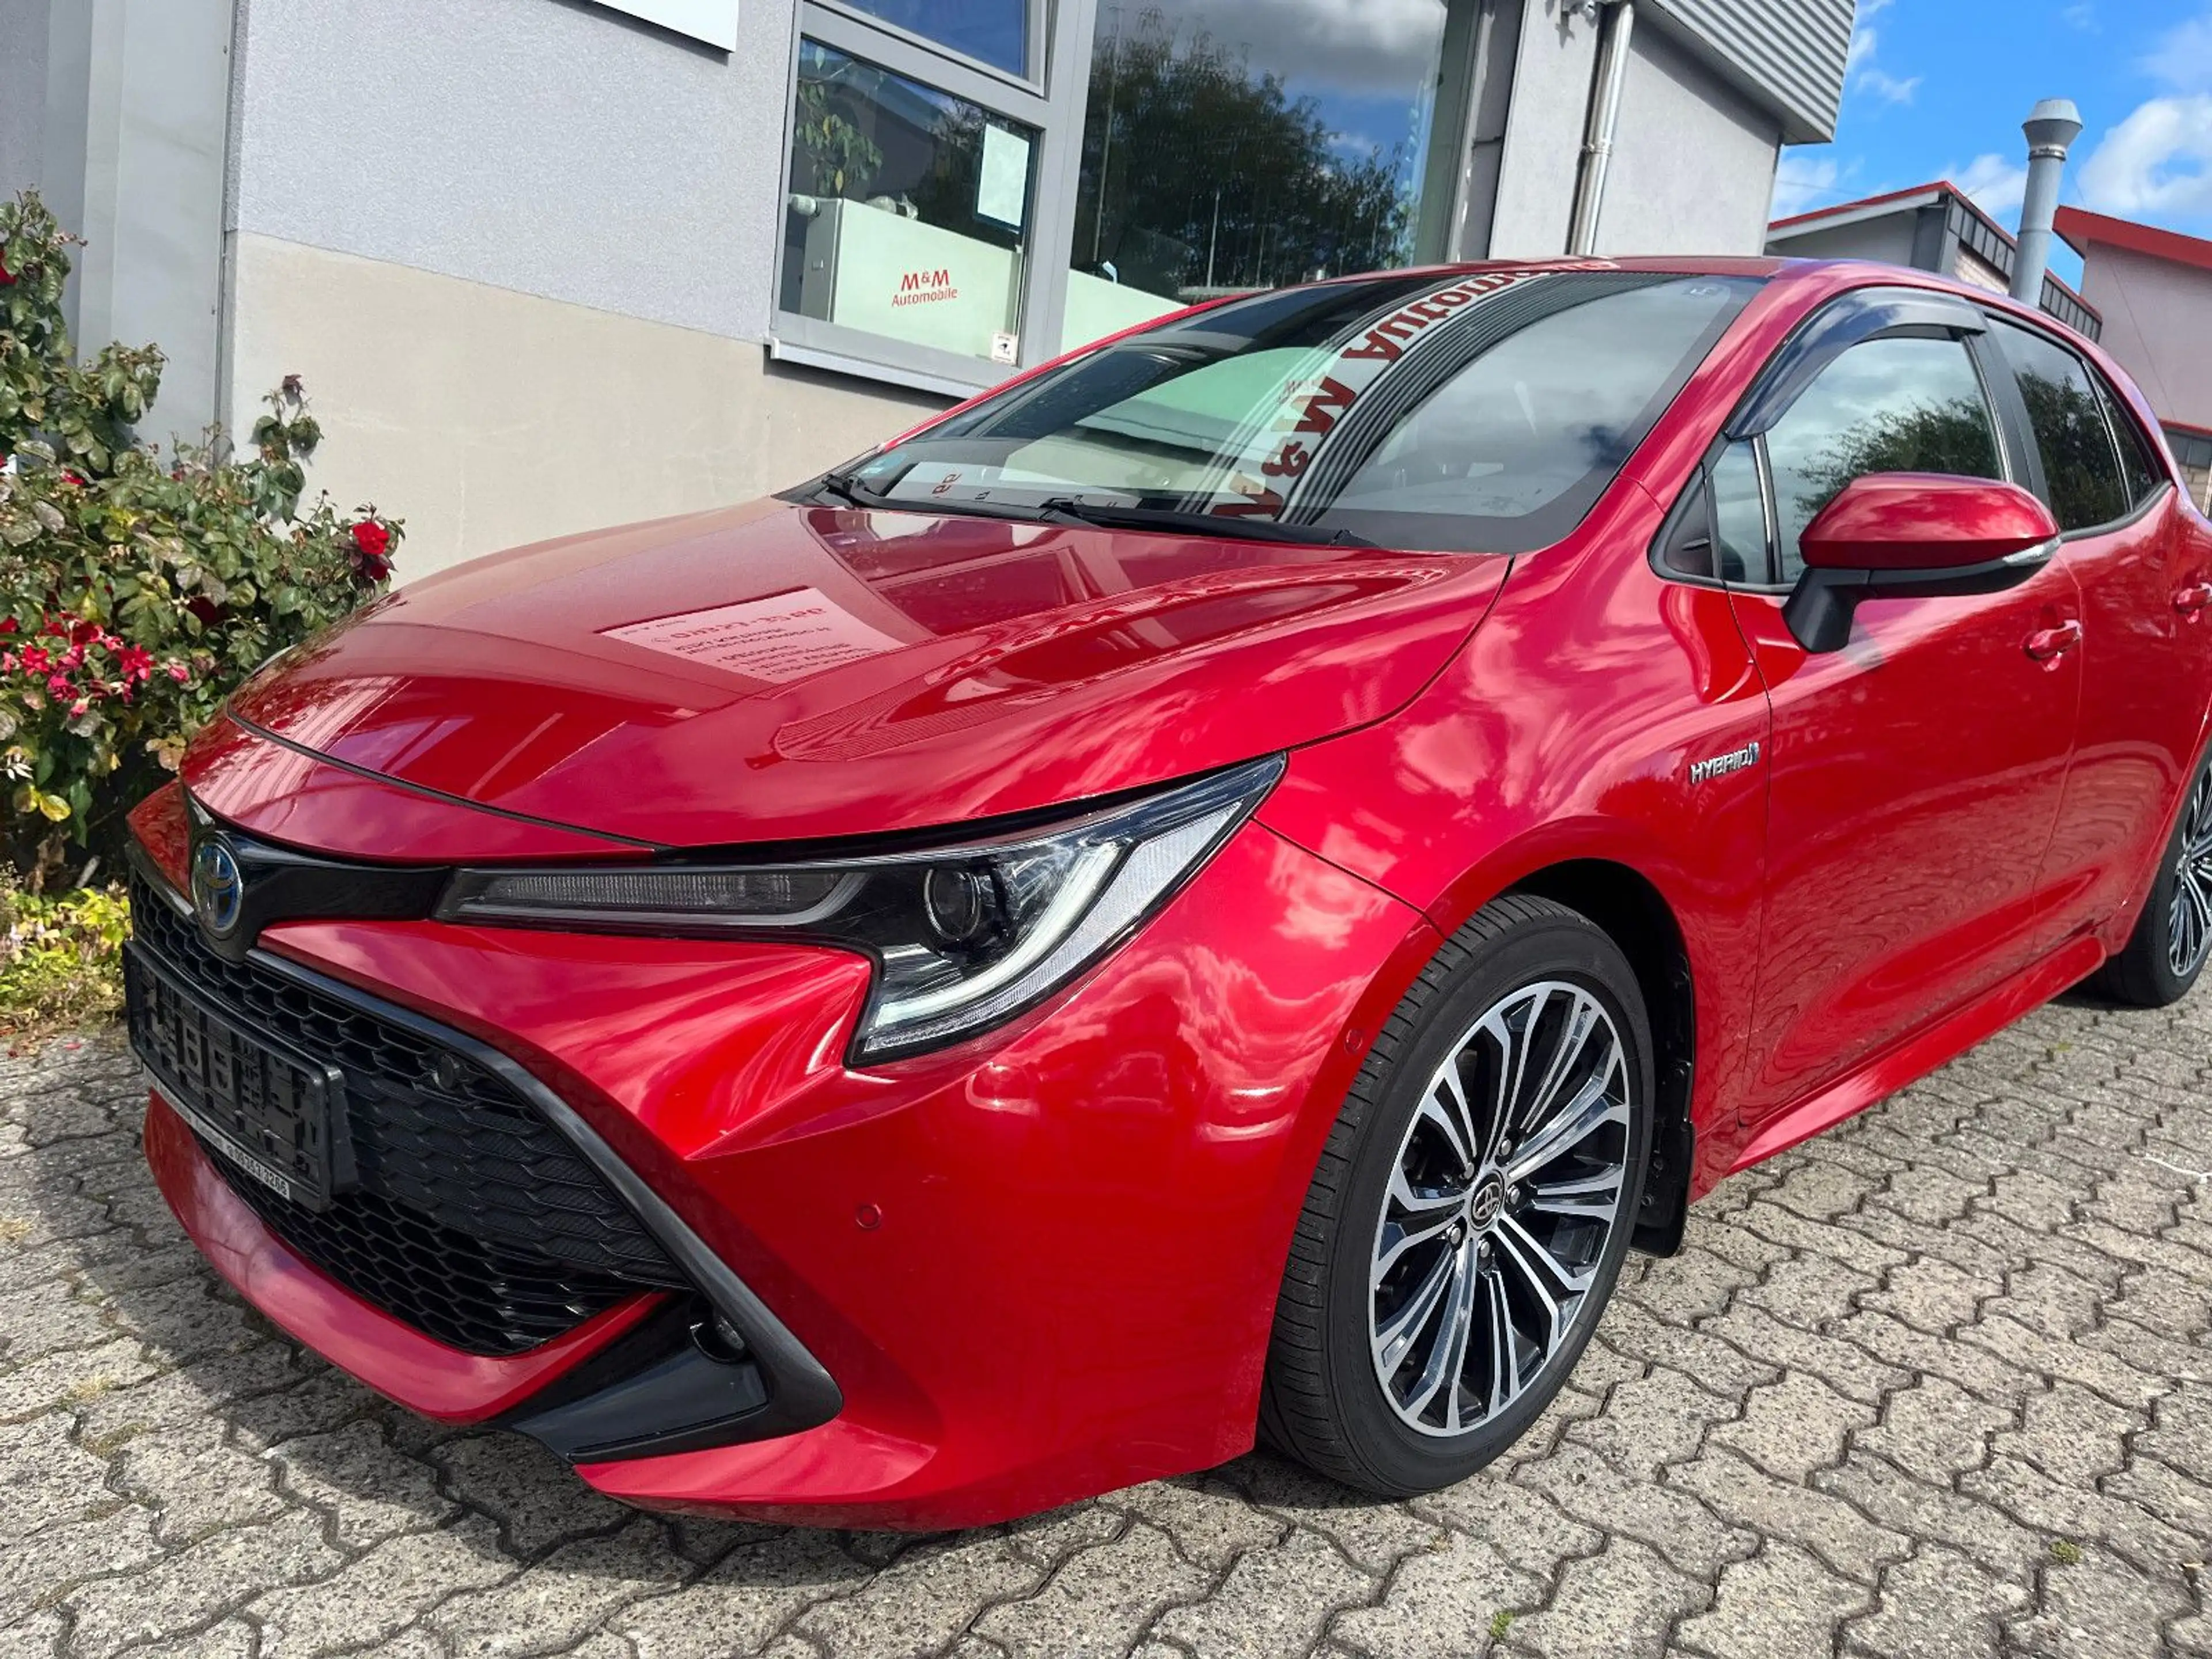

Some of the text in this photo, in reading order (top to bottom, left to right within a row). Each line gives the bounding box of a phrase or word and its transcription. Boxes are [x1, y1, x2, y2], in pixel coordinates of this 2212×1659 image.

[901, 269, 949, 291] M&M
[891, 287, 958, 307] Automobile
[1690, 750, 1749, 785] HYBRID
